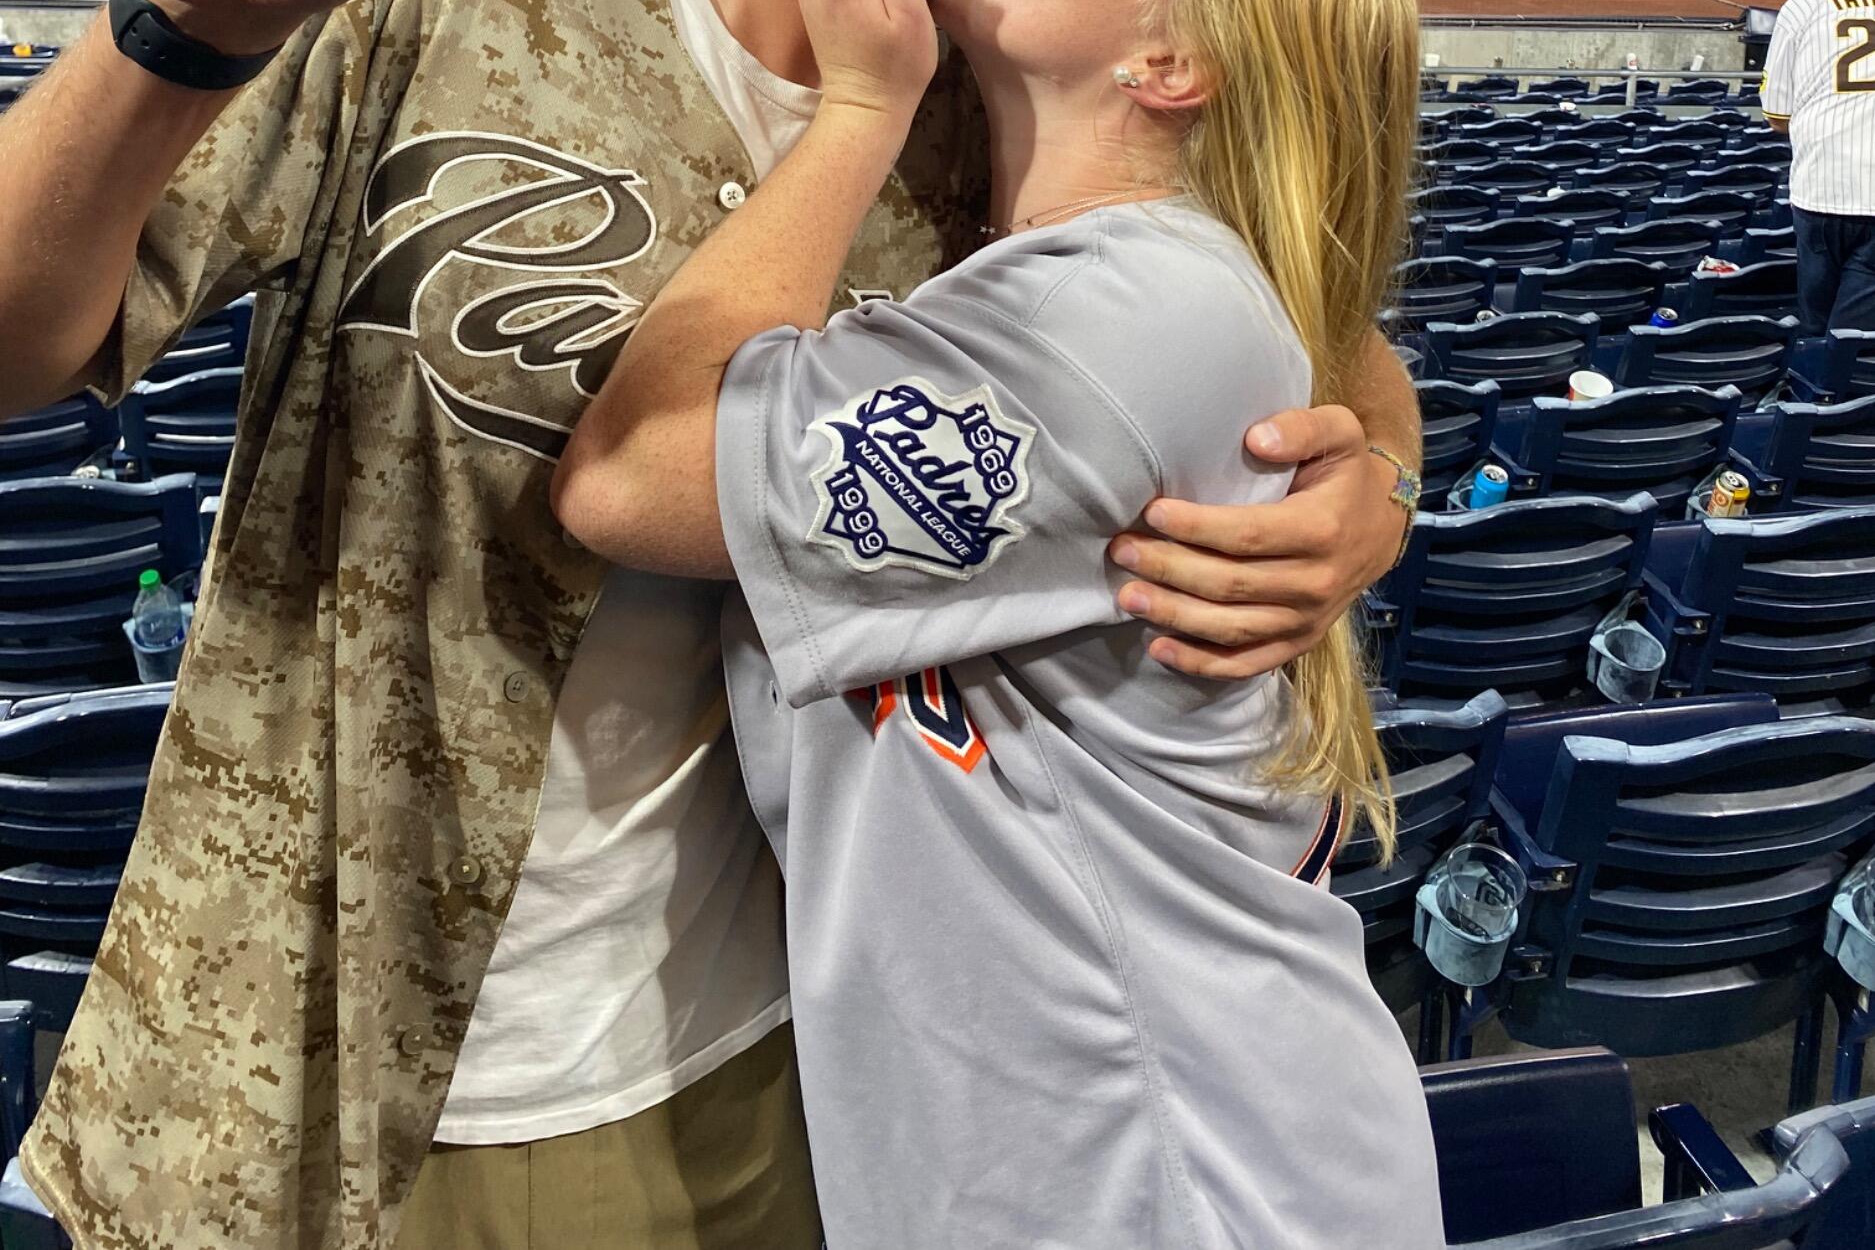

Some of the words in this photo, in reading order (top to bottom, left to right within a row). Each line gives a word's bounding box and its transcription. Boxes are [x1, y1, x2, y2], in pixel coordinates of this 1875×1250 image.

[855, 440, 925, 512] NATIONAL
[921, 510, 973, 558] LEAGUE
[856, 384, 1011, 548] Padres
[962, 406, 1016, 495] 1969
[830, 472, 885, 552] 1999
